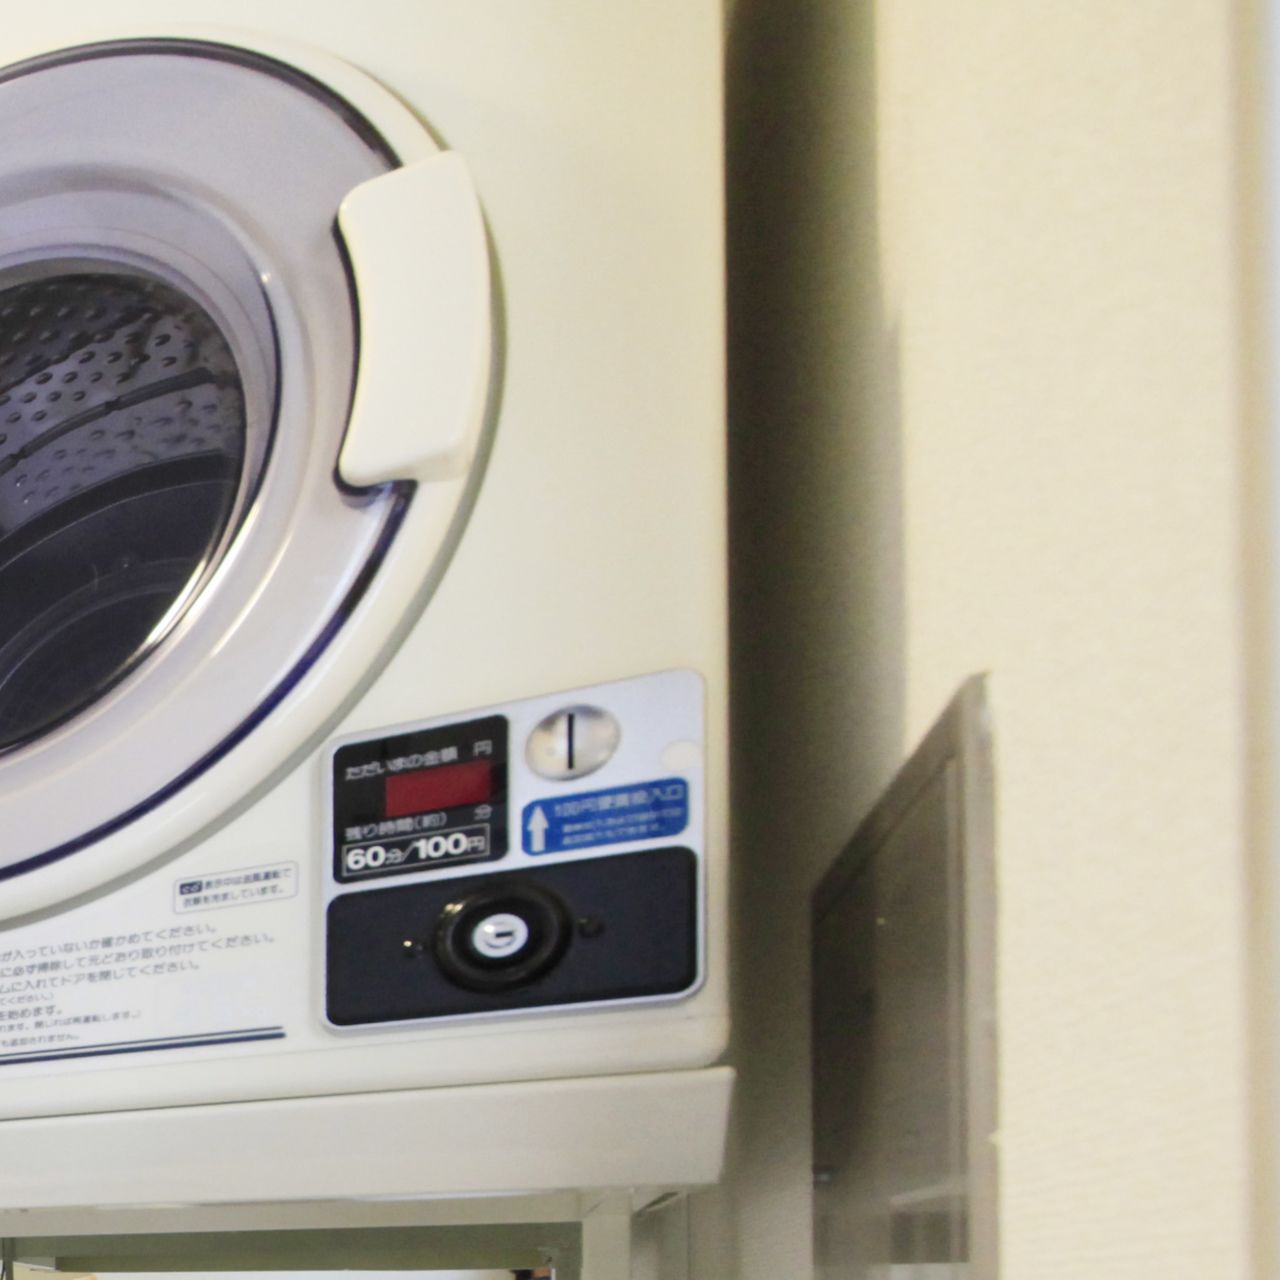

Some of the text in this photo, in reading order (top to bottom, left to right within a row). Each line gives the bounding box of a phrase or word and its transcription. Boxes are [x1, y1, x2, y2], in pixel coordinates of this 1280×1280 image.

[473, 740, 493, 757] 円
[473, 804, 493, 820] 分
[346, 833, 486, 871] 60分/100円
